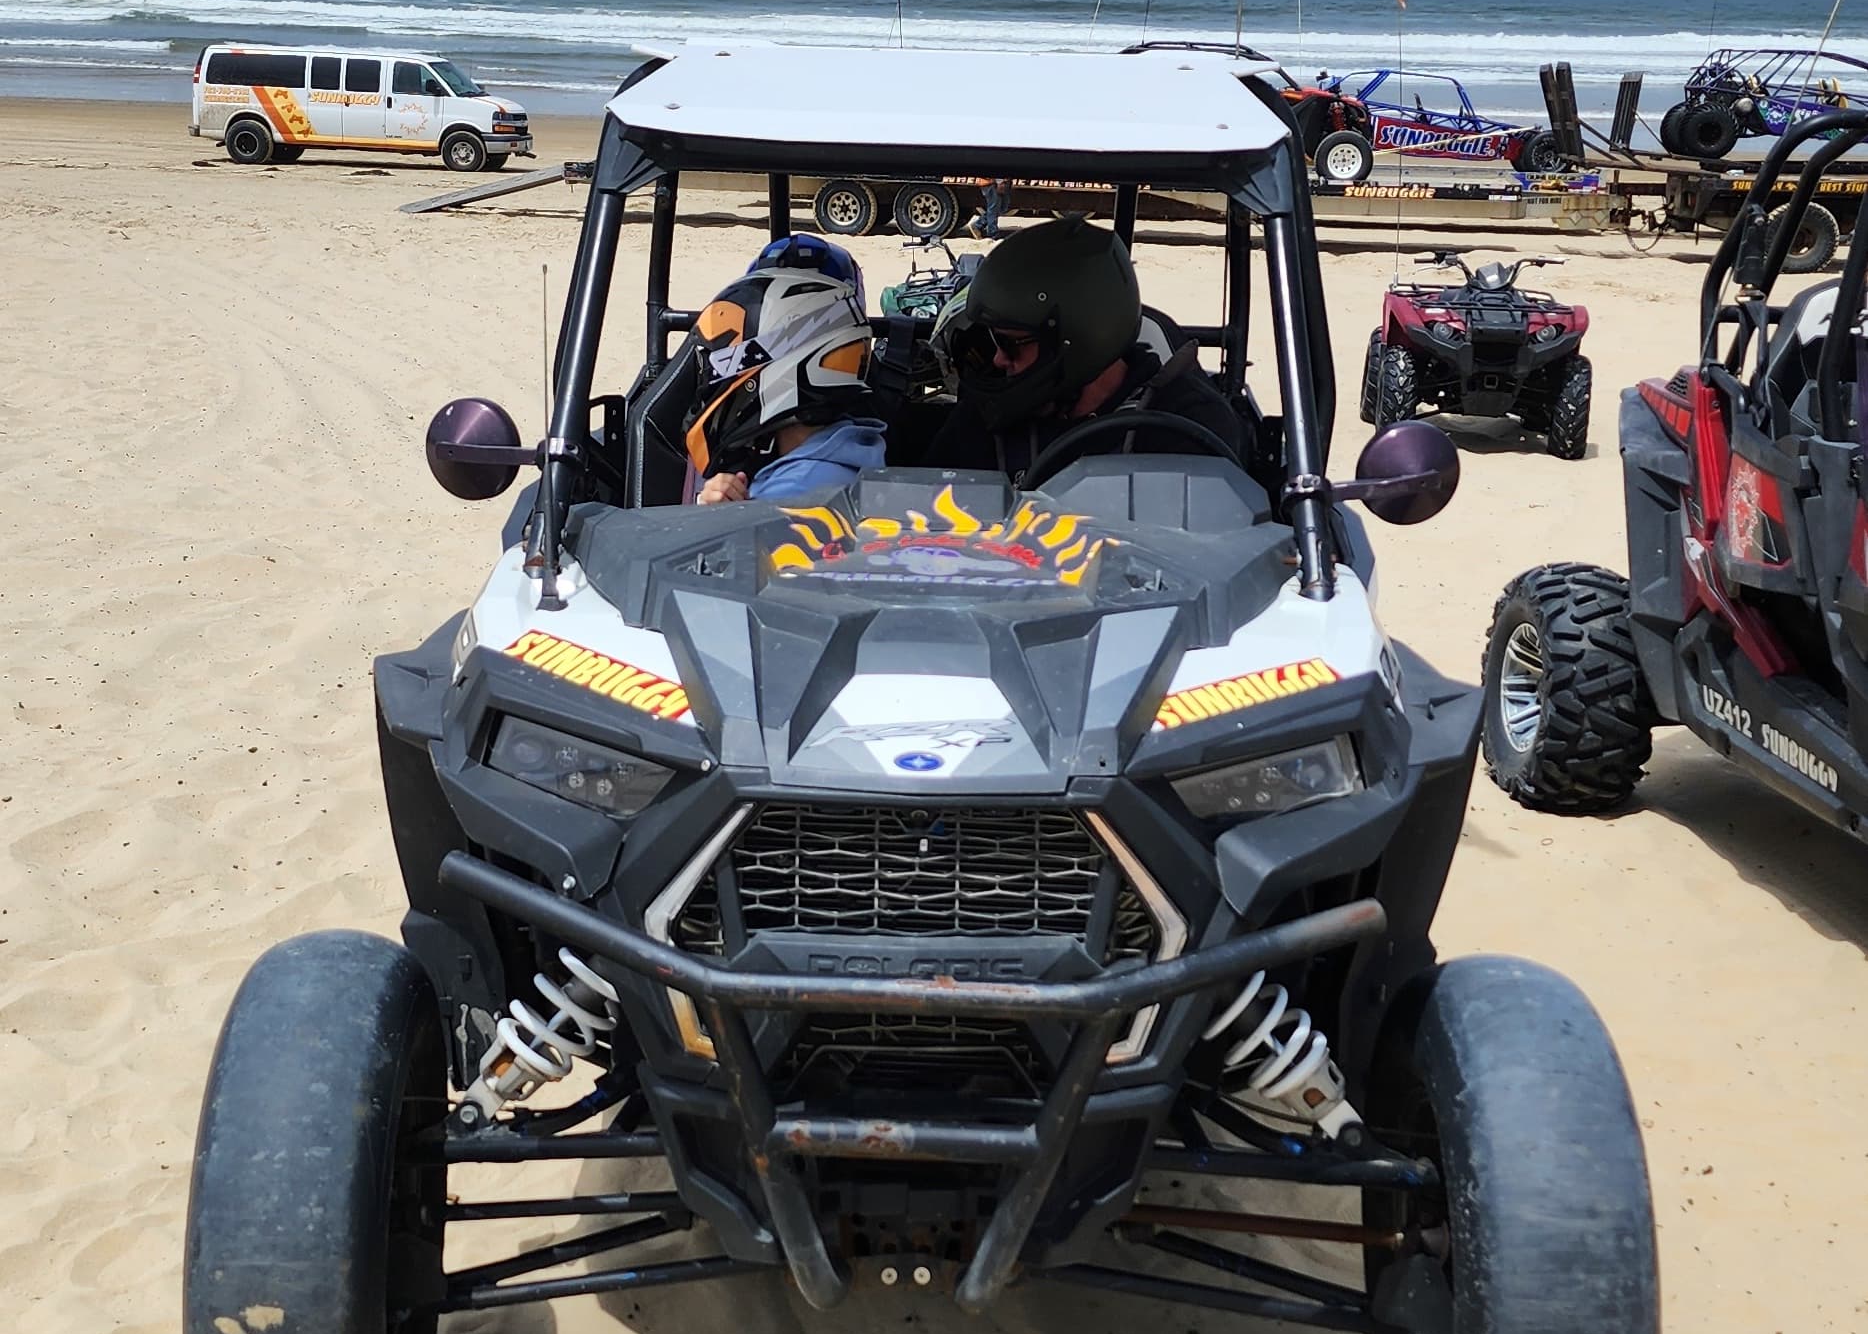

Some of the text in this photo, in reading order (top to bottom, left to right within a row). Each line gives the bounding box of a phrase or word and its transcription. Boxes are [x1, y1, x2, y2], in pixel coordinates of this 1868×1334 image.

[1344, 185, 1436, 199] SUNBUGGIE
[503, 632, 690, 719] SUNBUGGY
[1155, 657, 1338, 729] SUNBUGGY
[931, 736, 1013, 749] XP
[1703, 685, 1838, 793] UZ412 SUNBUGGY
[808, 953, 1025, 979] POLARIS
